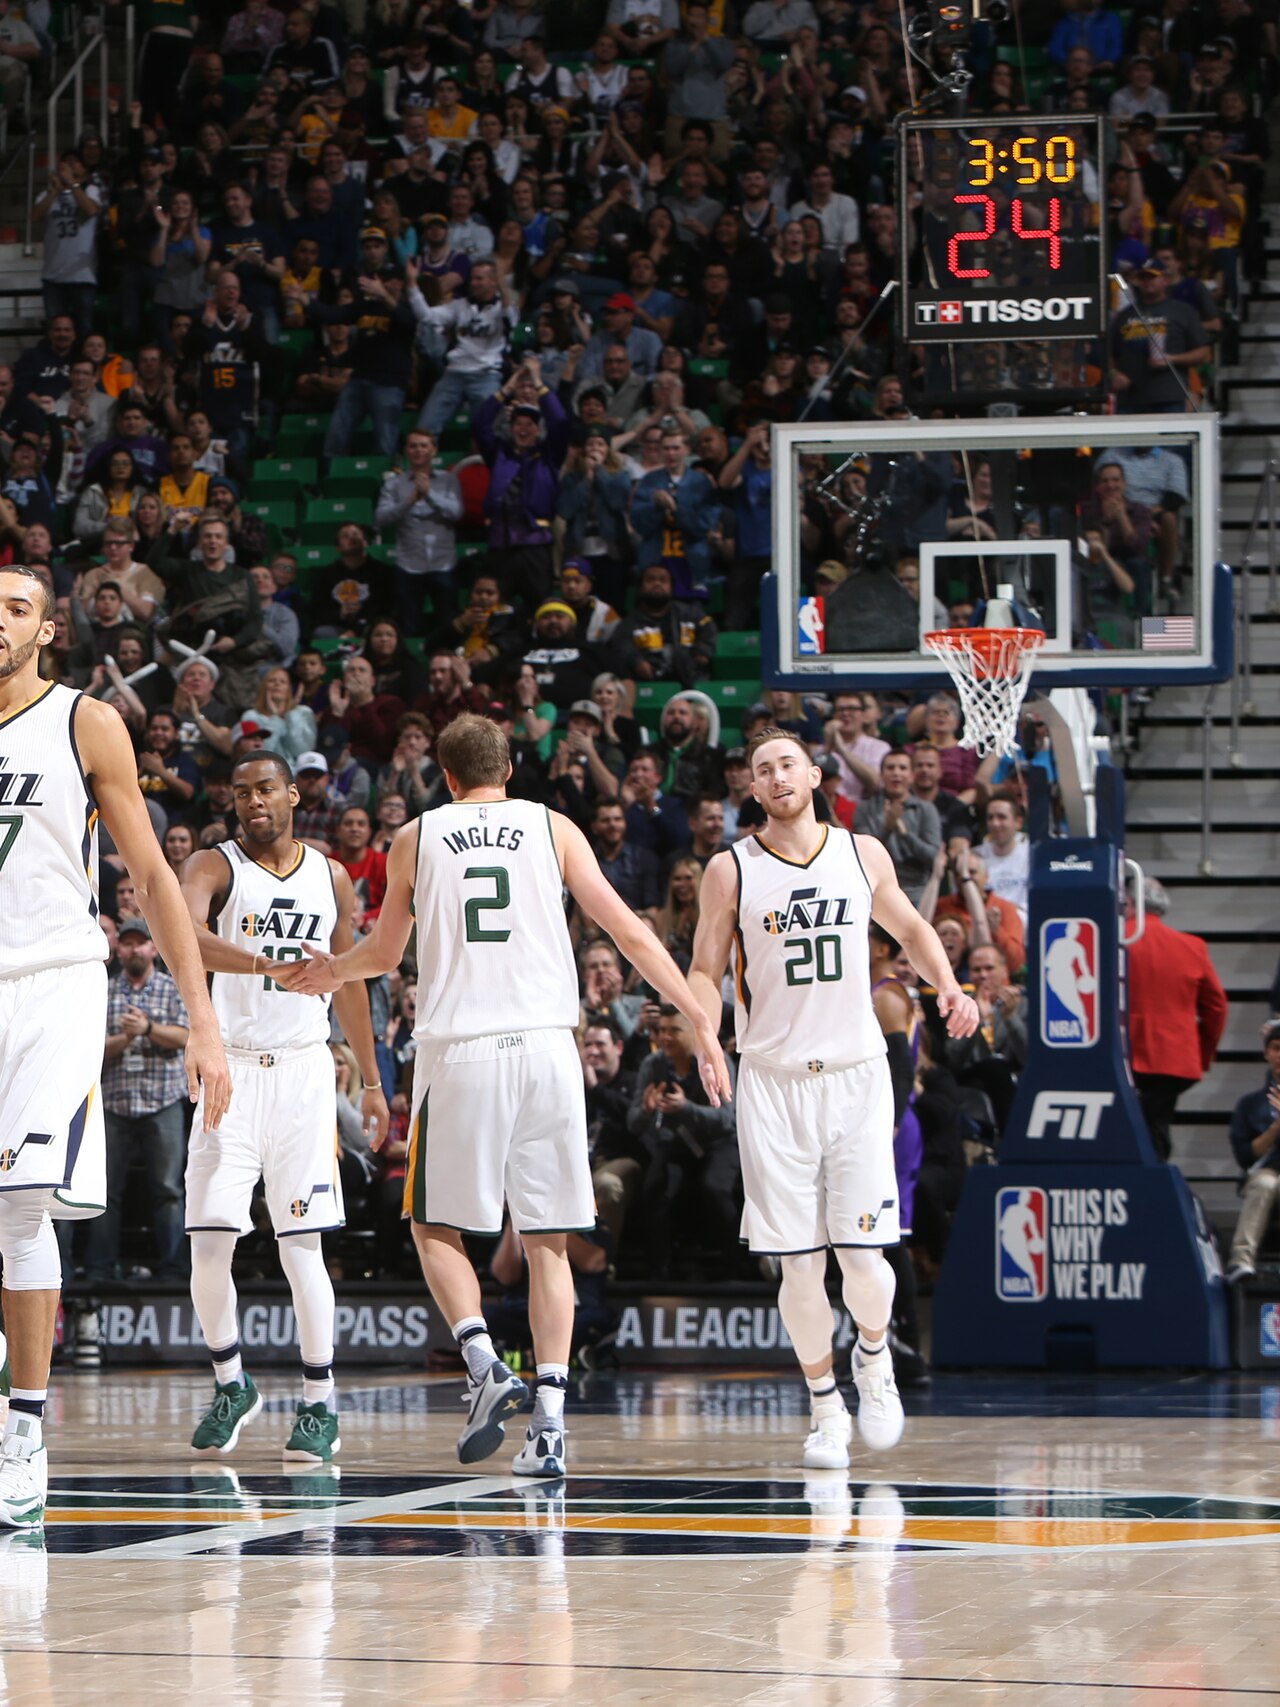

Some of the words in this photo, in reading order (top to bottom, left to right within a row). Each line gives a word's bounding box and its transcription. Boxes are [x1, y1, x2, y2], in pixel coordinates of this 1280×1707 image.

[968, 136, 1075, 186] 3:50
[948, 194, 1061, 278] 24
[964, 297, 1092, 323] TISSOT
[442, 826, 524, 855] INGLES
[463, 867, 511, 942] 2
[784, 934, 842, 986] 20
[497, 1034, 524, 1049] UTAH
[1048, 1020, 1081, 1038] NBA
[1026, 1091, 1115, 1140] FIT
[1048, 1188, 1103, 1226] THIS
[1104, 1188, 1129, 1226] IS
[1050, 1225, 1105, 1262] WHY
[1002, 1276, 1031, 1292] NBA
[1052, 1262, 1089, 1300] WE
[1089, 1262, 1147, 1300] PLAY
[333, 1305, 428, 1347] PASS
